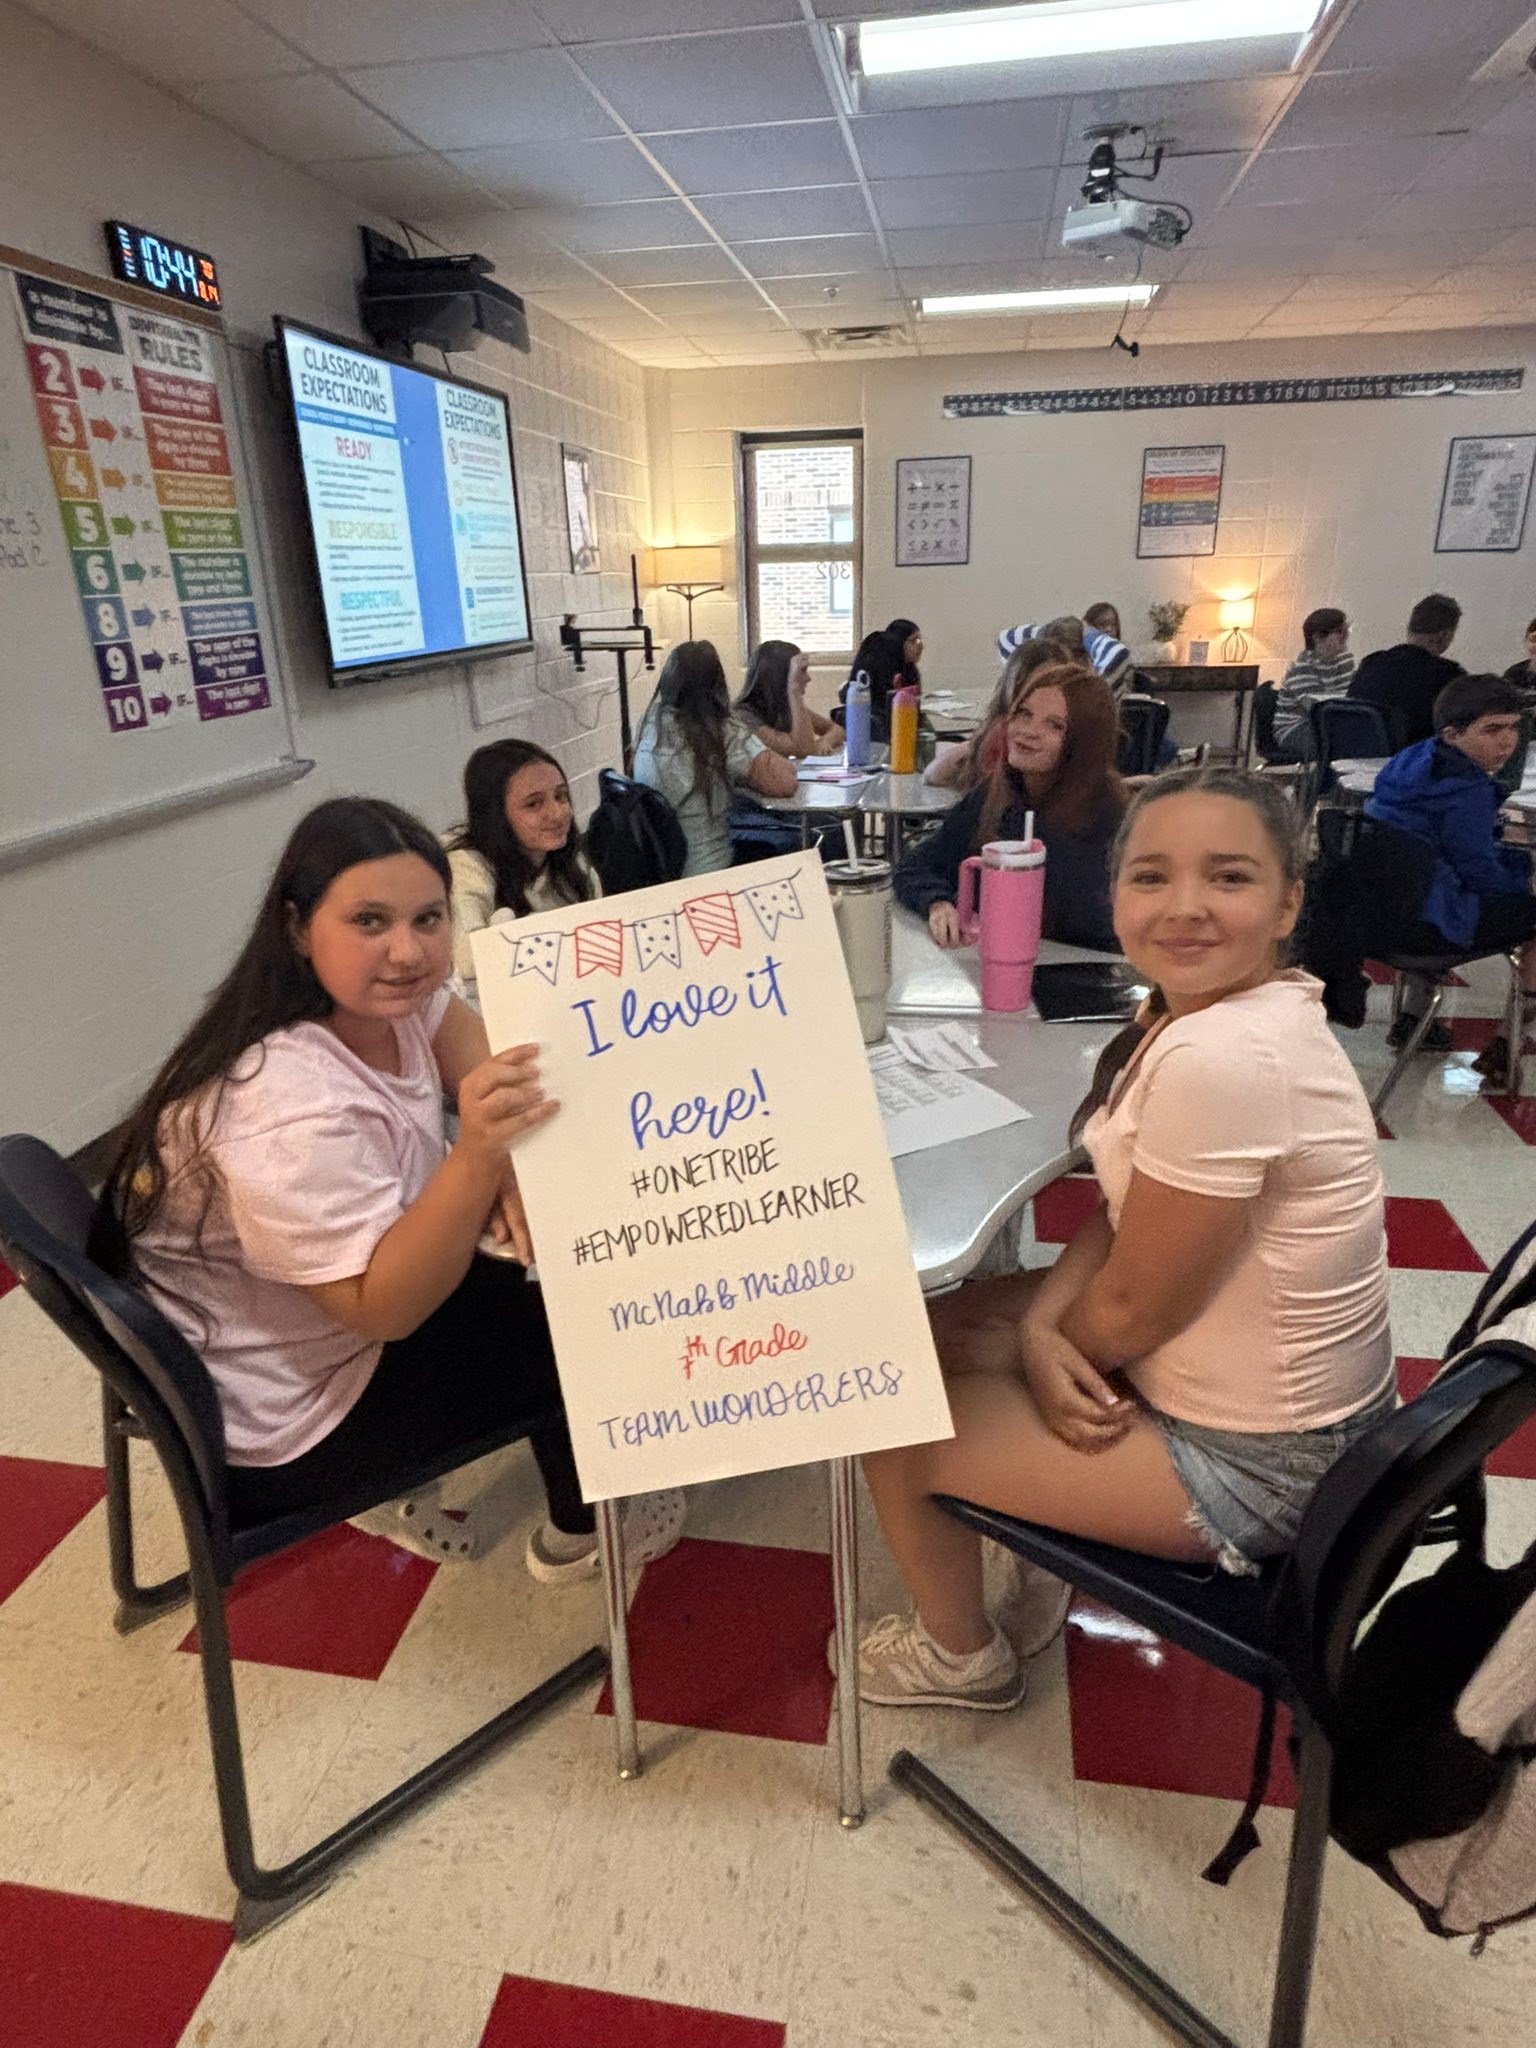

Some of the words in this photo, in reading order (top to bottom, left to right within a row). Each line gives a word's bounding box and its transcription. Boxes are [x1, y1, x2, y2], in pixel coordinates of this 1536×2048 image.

[39, 351, 68, 393] 2
[140, 336, 202, 372] RULES
[304, 346, 381, 388] CLASSROOM
[300, 373, 388, 415] EXPECTATIONS
[447, 388, 498, 417] CLASSROOM
[1185, 391, 1196, 404] 0
[1211, 390, 1219, 402] 2
[1222, 390, 1231, 402] 3
[1235, 389, 1244, 401] 4
[1247, 389, 1255, 401] 5
[1263, 390, 1271, 401] 6
[1274, 389, 1281, 400] 7
[1285, 388, 1293, 400] 8
[1296, 388, 1304, 399] 9
[1307, 387, 1320, 399] 10
[1336, 384, 1347, 397] 12
[50, 405, 76, 444] 3
[444, 410, 503, 440] EXPECTATIONS
[336, 436, 372, 460] READY
[65, 456, 89, 493] 4
[74, 506, 98, 542] 5
[86, 554, 110, 590] 6
[97, 602, 120, 638] 8
[105, 647, 128, 681] 9
[111, 696, 141, 725] 10
[572, 999, 614, 1057] I
[622, 983, 738, 1039] love
[746, 955, 788, 1017] it
[630, 1068, 771, 1150] here!
[630, 1137, 780, 1198] #ONETRIBE
[571, 1173, 866, 1266] #EMPOWEREDLEARNER
[715, 1322, 808, 1368] Grade
[598, 1404, 689, 1450] TEAM
